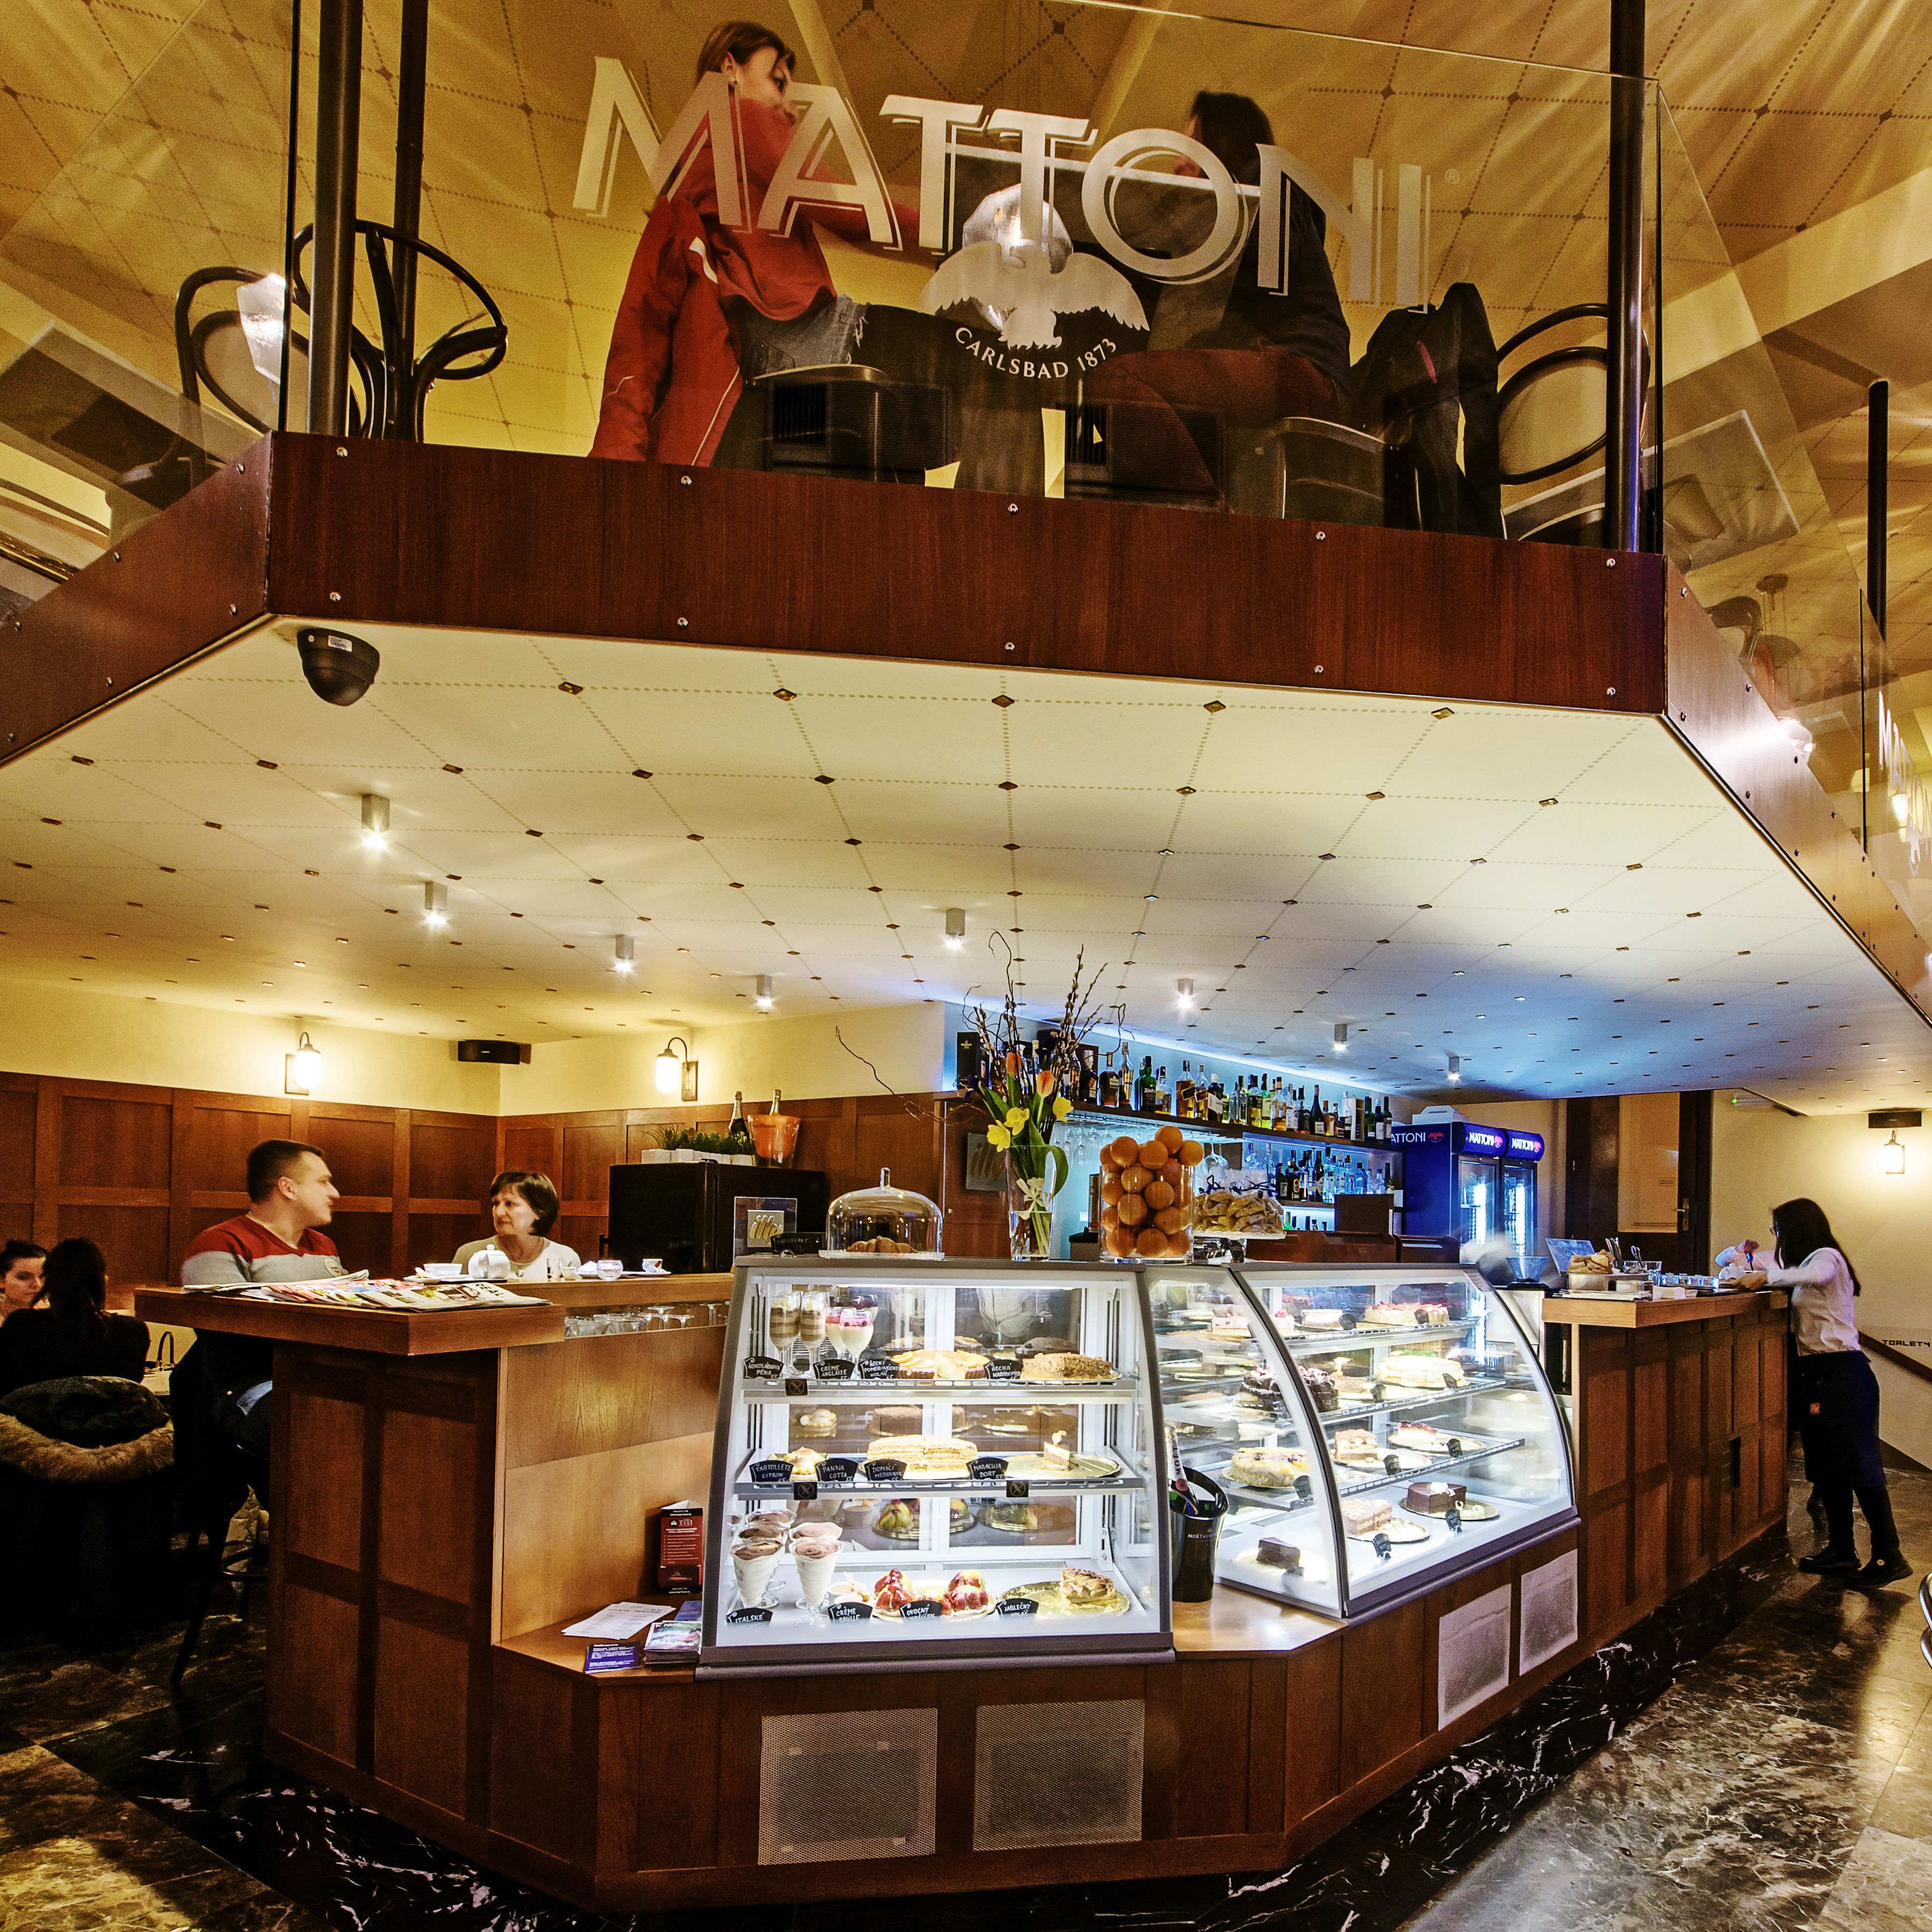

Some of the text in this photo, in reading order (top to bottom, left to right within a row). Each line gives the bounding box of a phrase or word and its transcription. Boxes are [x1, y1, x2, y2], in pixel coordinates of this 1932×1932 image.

[573, 57, 1432, 314] MATTONI
[955, 327, 1116, 378] CARLSBAD 1873
[1391, 1132, 1426, 1143] ATTONI
[1469, 1132, 1495, 1146] MATTONI
[1511, 1138, 1534, 1151] MATTONI
[1882, 1339, 1930, 1347] TOALETY
[822, 1465, 845, 1473] PANNA
[735, 1611, 765, 1623] ITALSKÉ
[836, 1606, 856, 1617] CRÈME
